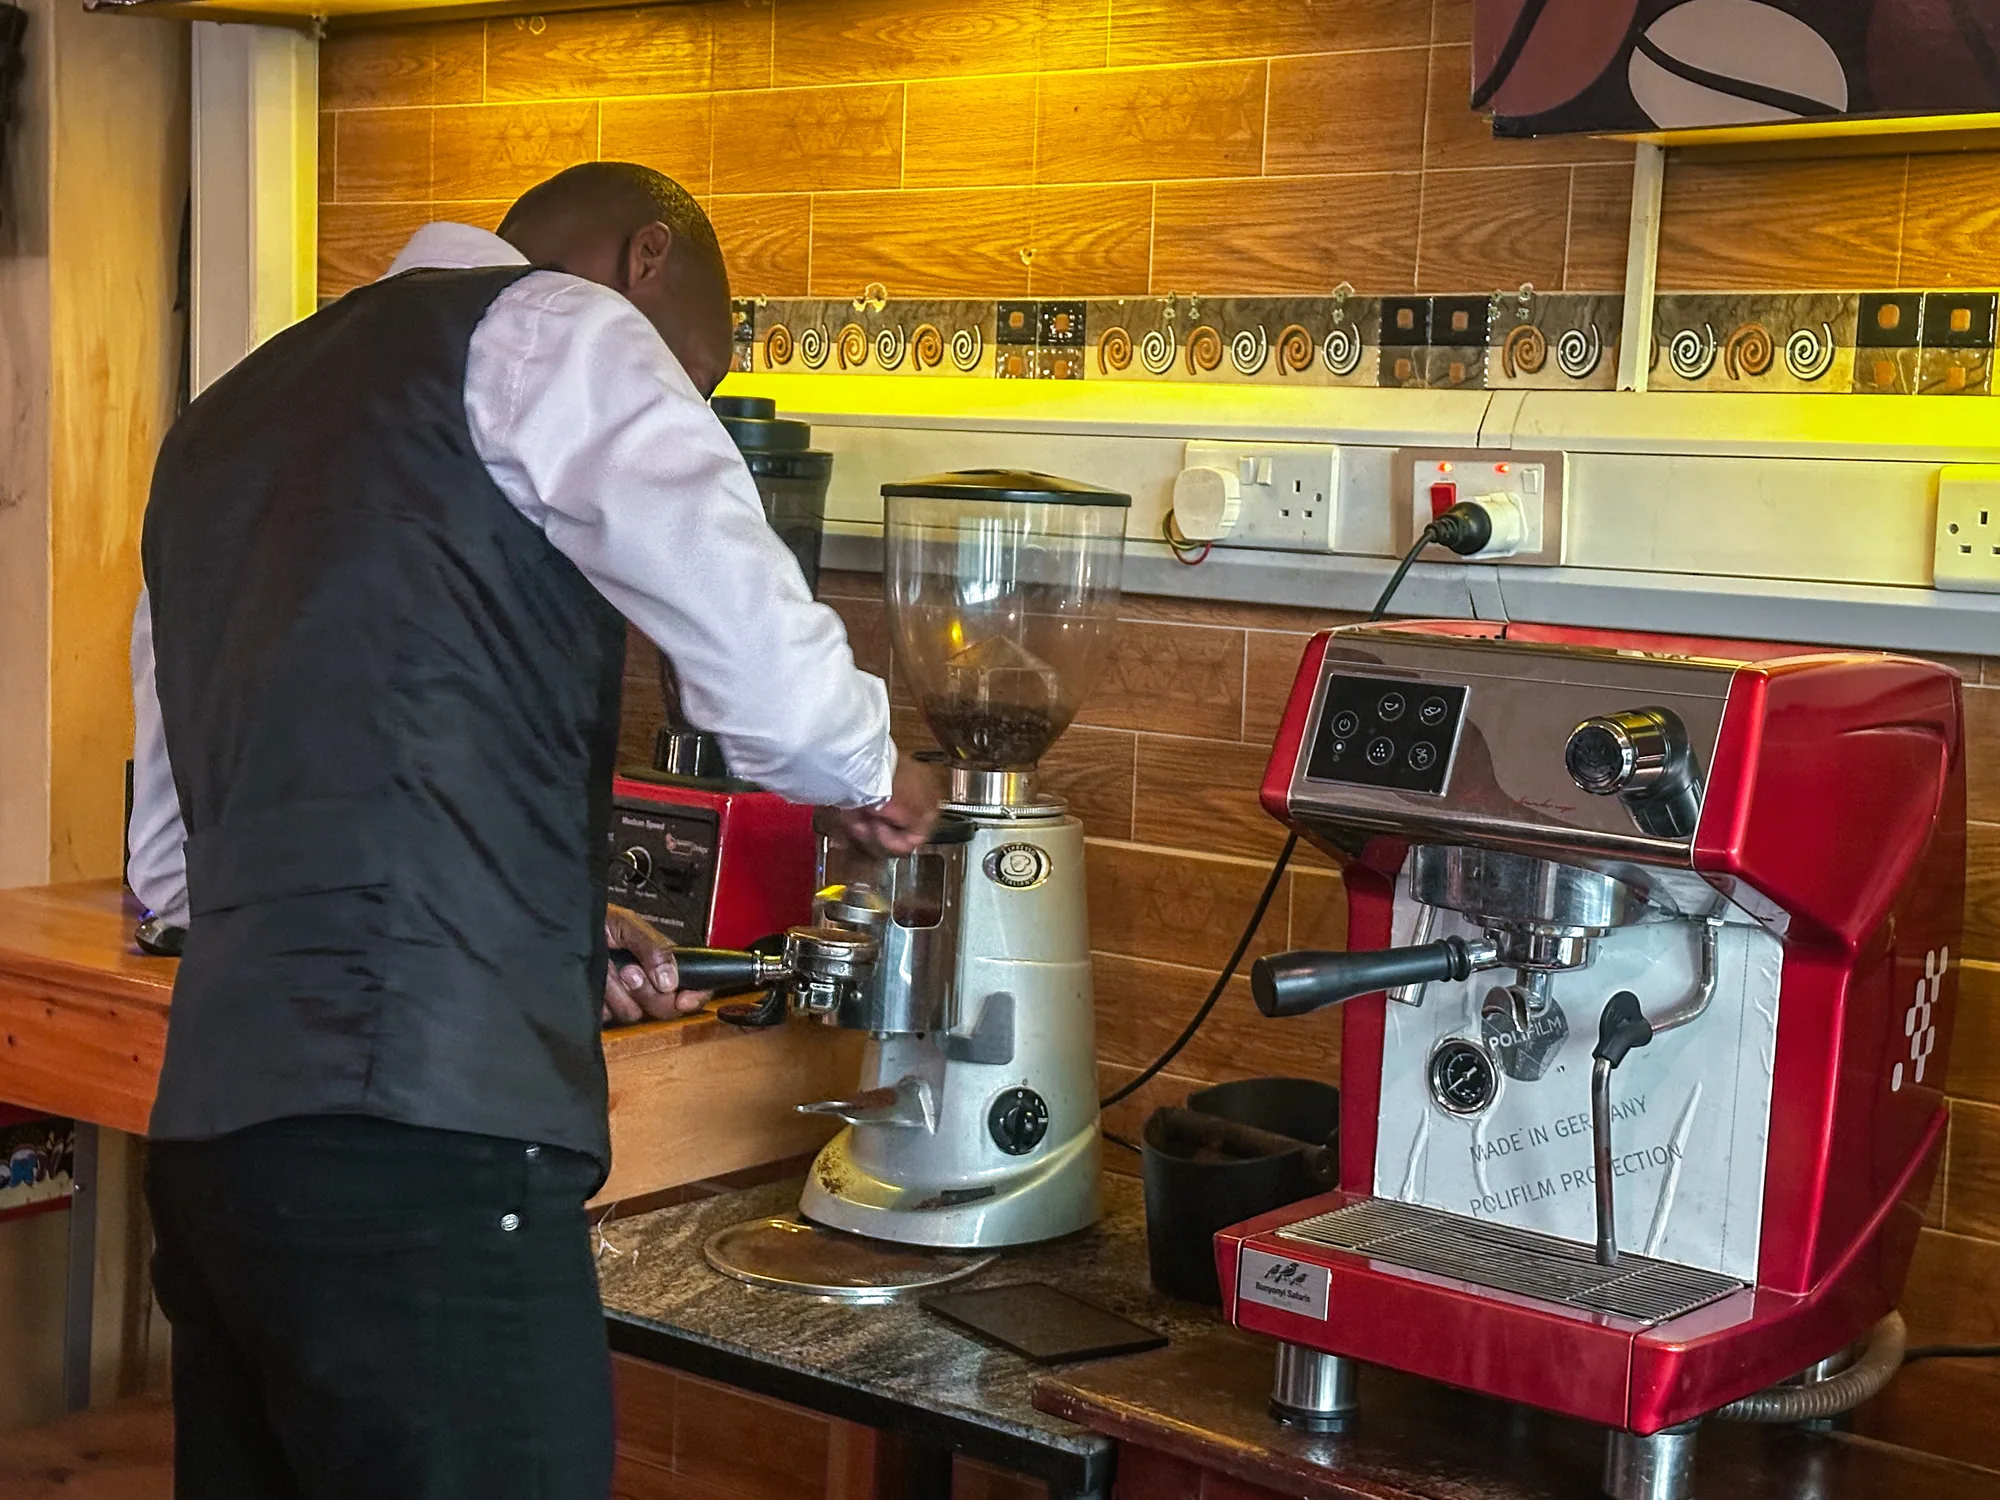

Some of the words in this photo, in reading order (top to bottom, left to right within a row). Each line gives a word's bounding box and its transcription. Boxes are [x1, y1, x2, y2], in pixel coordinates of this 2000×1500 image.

[1488, 1015, 1562, 1051] POLIFILM
[1470, 1131, 1524, 1165] MADE
[1528, 1125, 1550, 1147] IN
[1555, 1095, 1648, 1138] GERANY
[1470, 1177, 1556, 1217] POLIFILM
[1560, 1141, 1683, 1192] PROECTION
